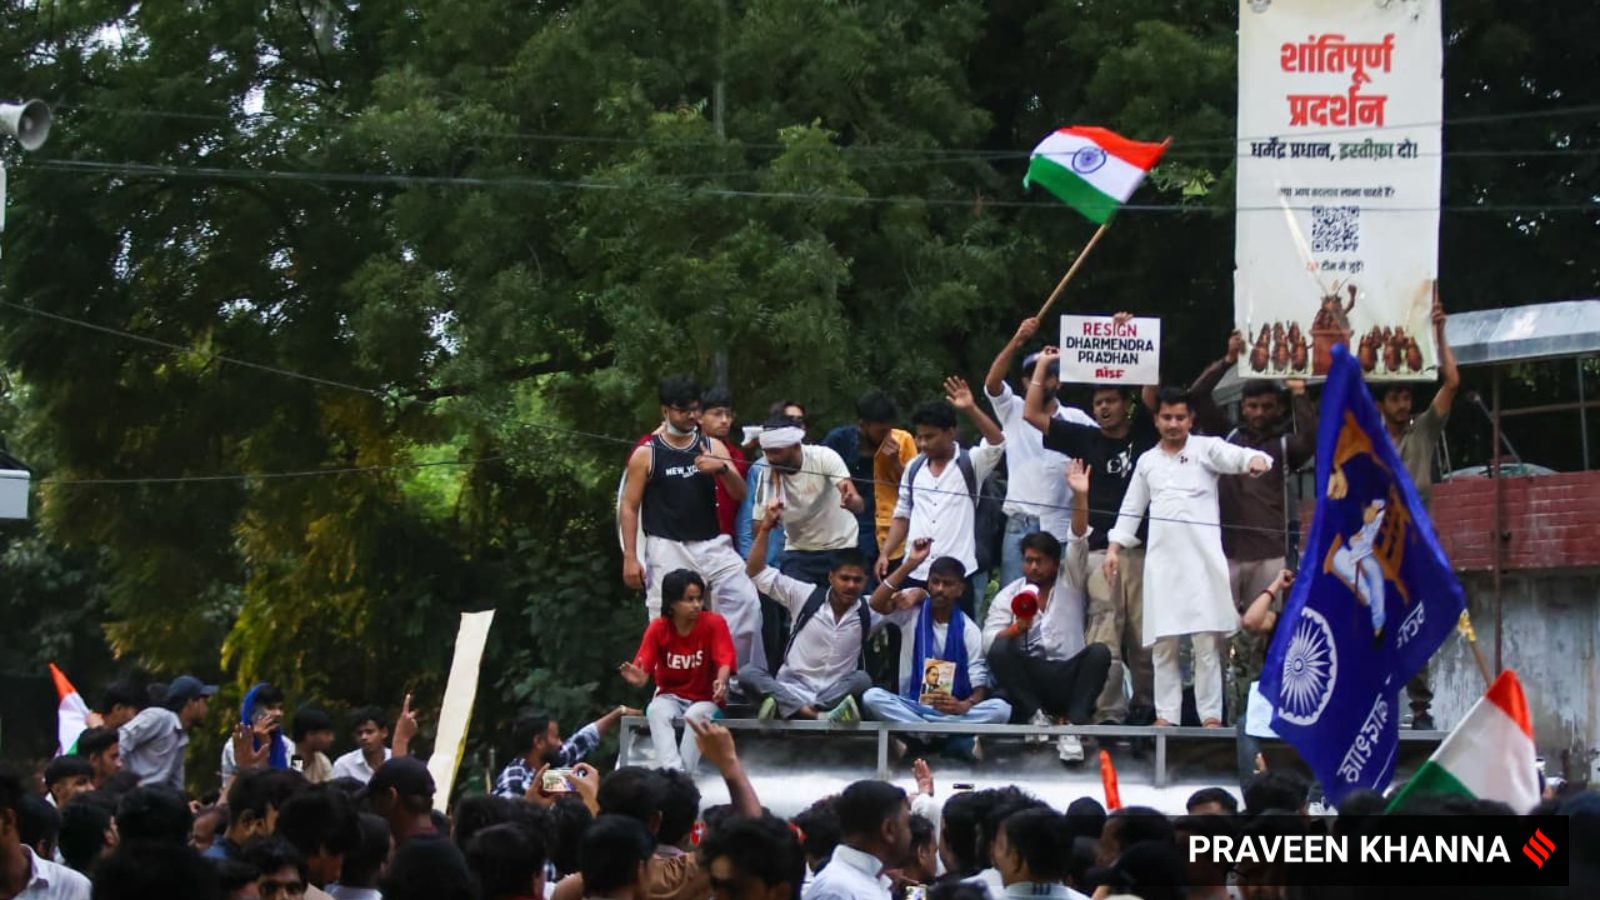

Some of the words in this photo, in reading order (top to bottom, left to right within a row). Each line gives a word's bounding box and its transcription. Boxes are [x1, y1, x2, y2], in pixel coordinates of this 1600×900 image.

[1280, 33, 1395, 83] शांतिपूर्ण
[1287, 84, 1387, 128] प्रदर्शन
[1290, 142, 1335, 161] प्रधान,
[1083, 322, 1137, 337] RESIGN
[1066, 336, 1154, 351] DHARMENDRA
[1078, 350, 1138, 365] PRADHAN
[665, 466, 685, 476] NEW
